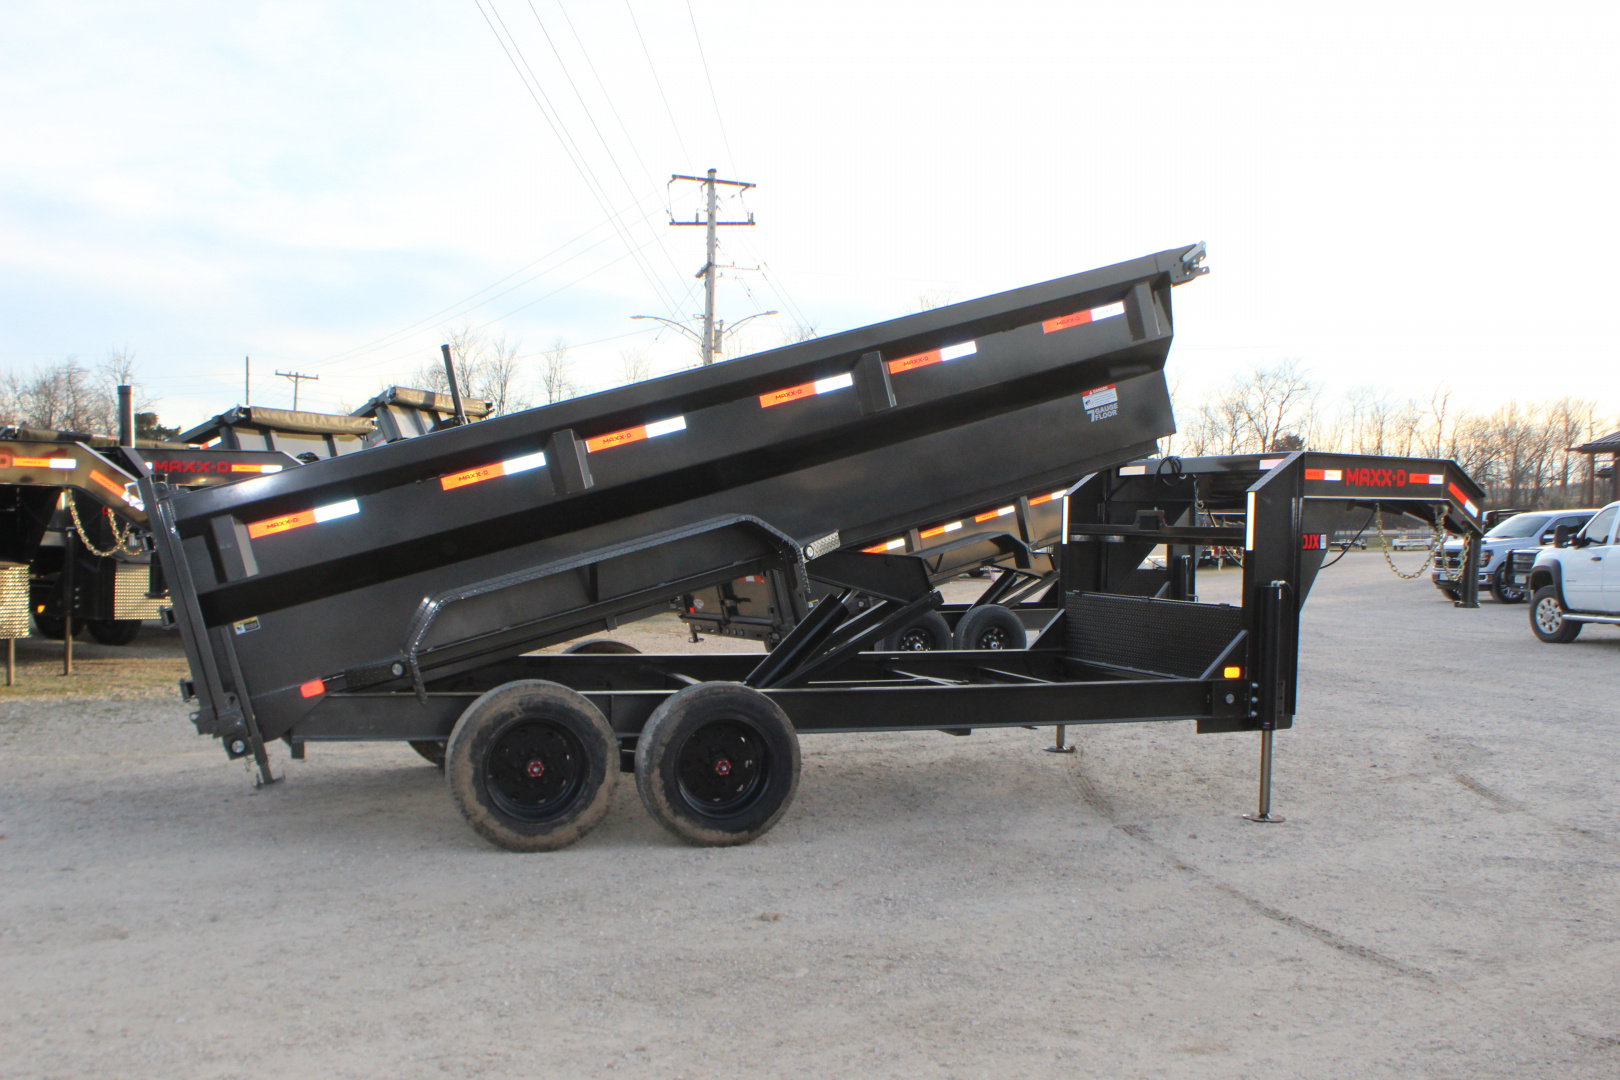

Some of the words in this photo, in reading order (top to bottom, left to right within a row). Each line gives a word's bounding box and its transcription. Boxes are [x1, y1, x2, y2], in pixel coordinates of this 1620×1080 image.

[1086, 410, 1095, 422] 7
[1095, 403, 1118, 414] GAUGE
[1095, 410, 1117, 421] FLOOR
[153, 460, 231, 473] MAXX-D
[1345, 468, 1406, 487] MAXX-D
